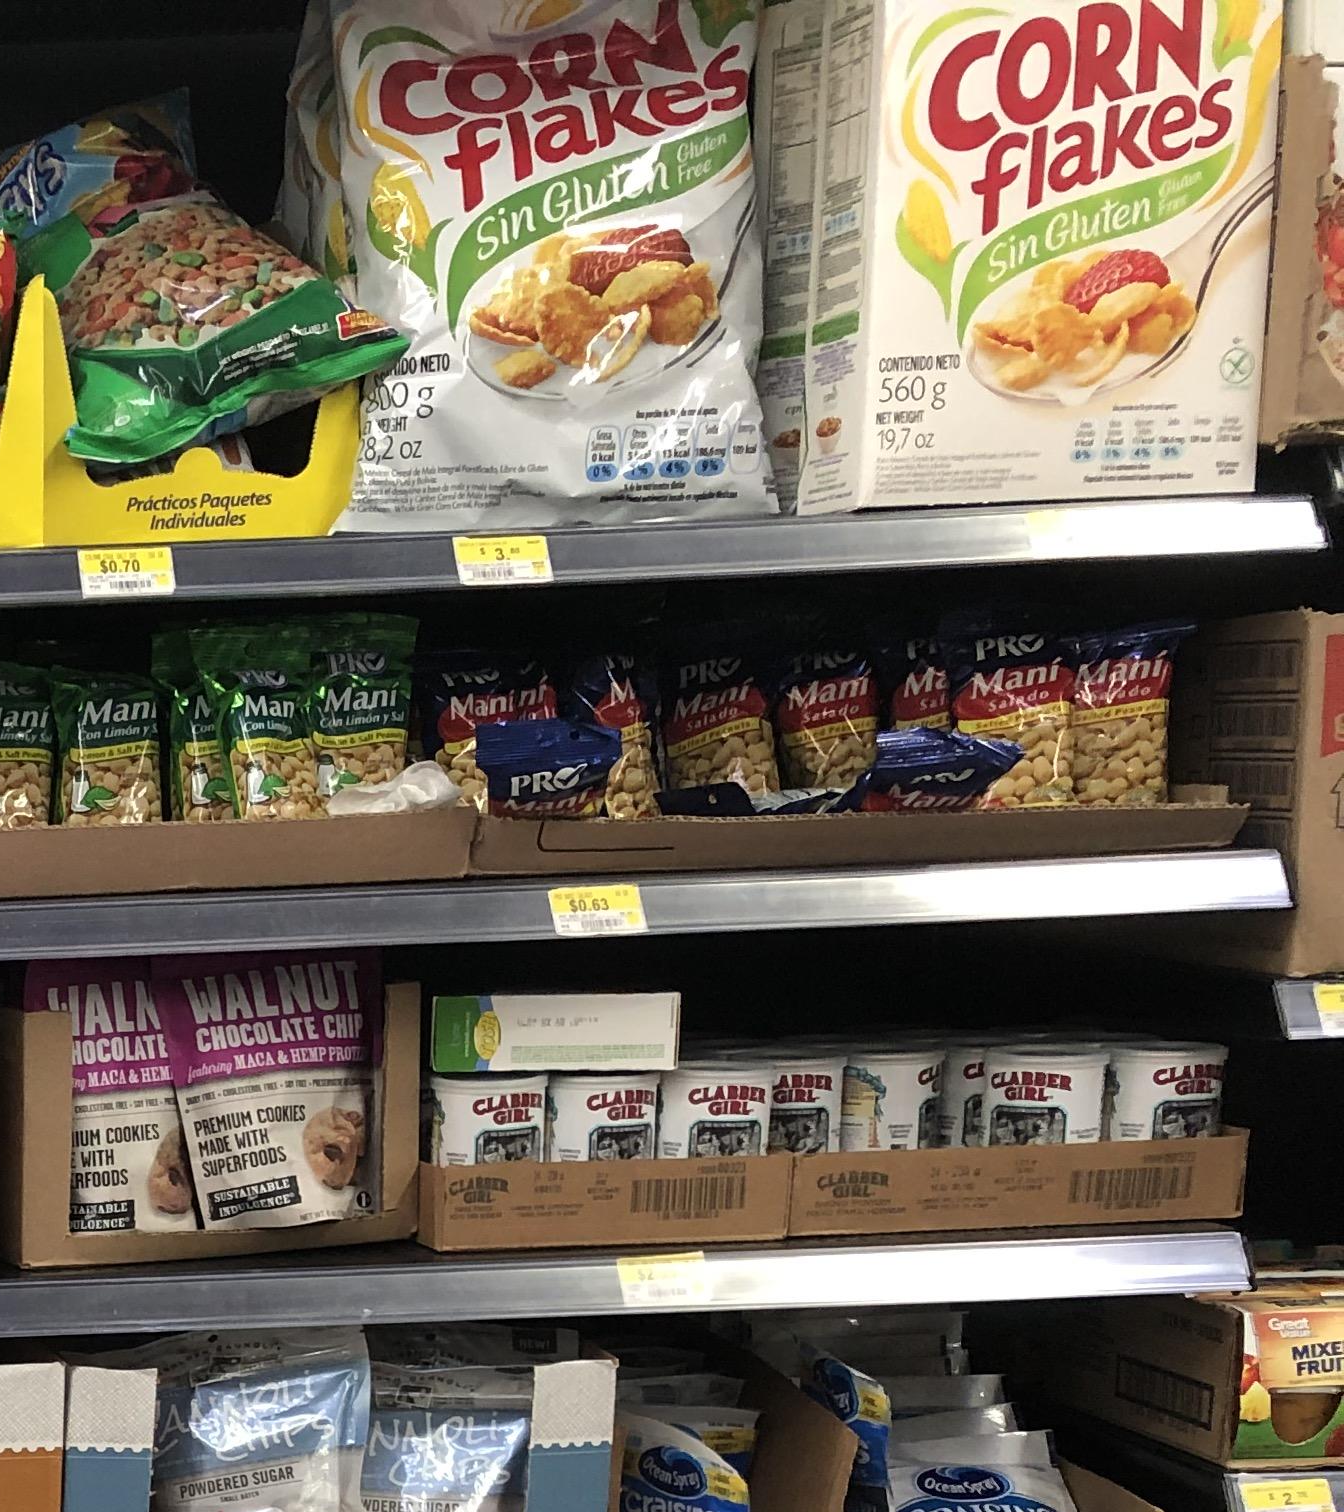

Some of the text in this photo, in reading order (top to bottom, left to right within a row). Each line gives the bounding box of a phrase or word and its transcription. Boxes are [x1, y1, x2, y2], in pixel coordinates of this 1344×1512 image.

[377, 9, 697, 136] CORN
[927, 2, 1201, 151] CORN
[444, 45, 748, 212] flakes
[971, 79, 1233, 235] flakes
[987, 194, 1151, 284] Sin Gluten
[878, 354, 960, 372] CONTENIDO NETO
[878, 377, 926, 403] 560
[876, 410, 924, 425] NET WEIGHT
[877, 430, 935, 454] 19,7 oz
[970, 660, 1062, 698] Maní
[568, 896, 610, 915] $0.63
[186, 961, 361, 1024] WALNUT
[194, 1010, 364, 1054] CHOCOLATE CHIP
[990, 1070, 1073, 1092] CLABBER
[1005, 1085, 1049, 1101] GIRL
[194, 1105, 306, 1137] PREMIUM COOKIES
[198, 1129, 270, 1158] MADE WITH
[202, 1146, 287, 1178] SUPERFOODS
[214, 1178, 290, 1203] SUSTAINABLE
[219, 1194, 291, 1218] INDULGENCE
[178, 1464, 295, 1499] POWDERED SUGAR
[924, 1474, 1000, 1496] Ocean Spray
